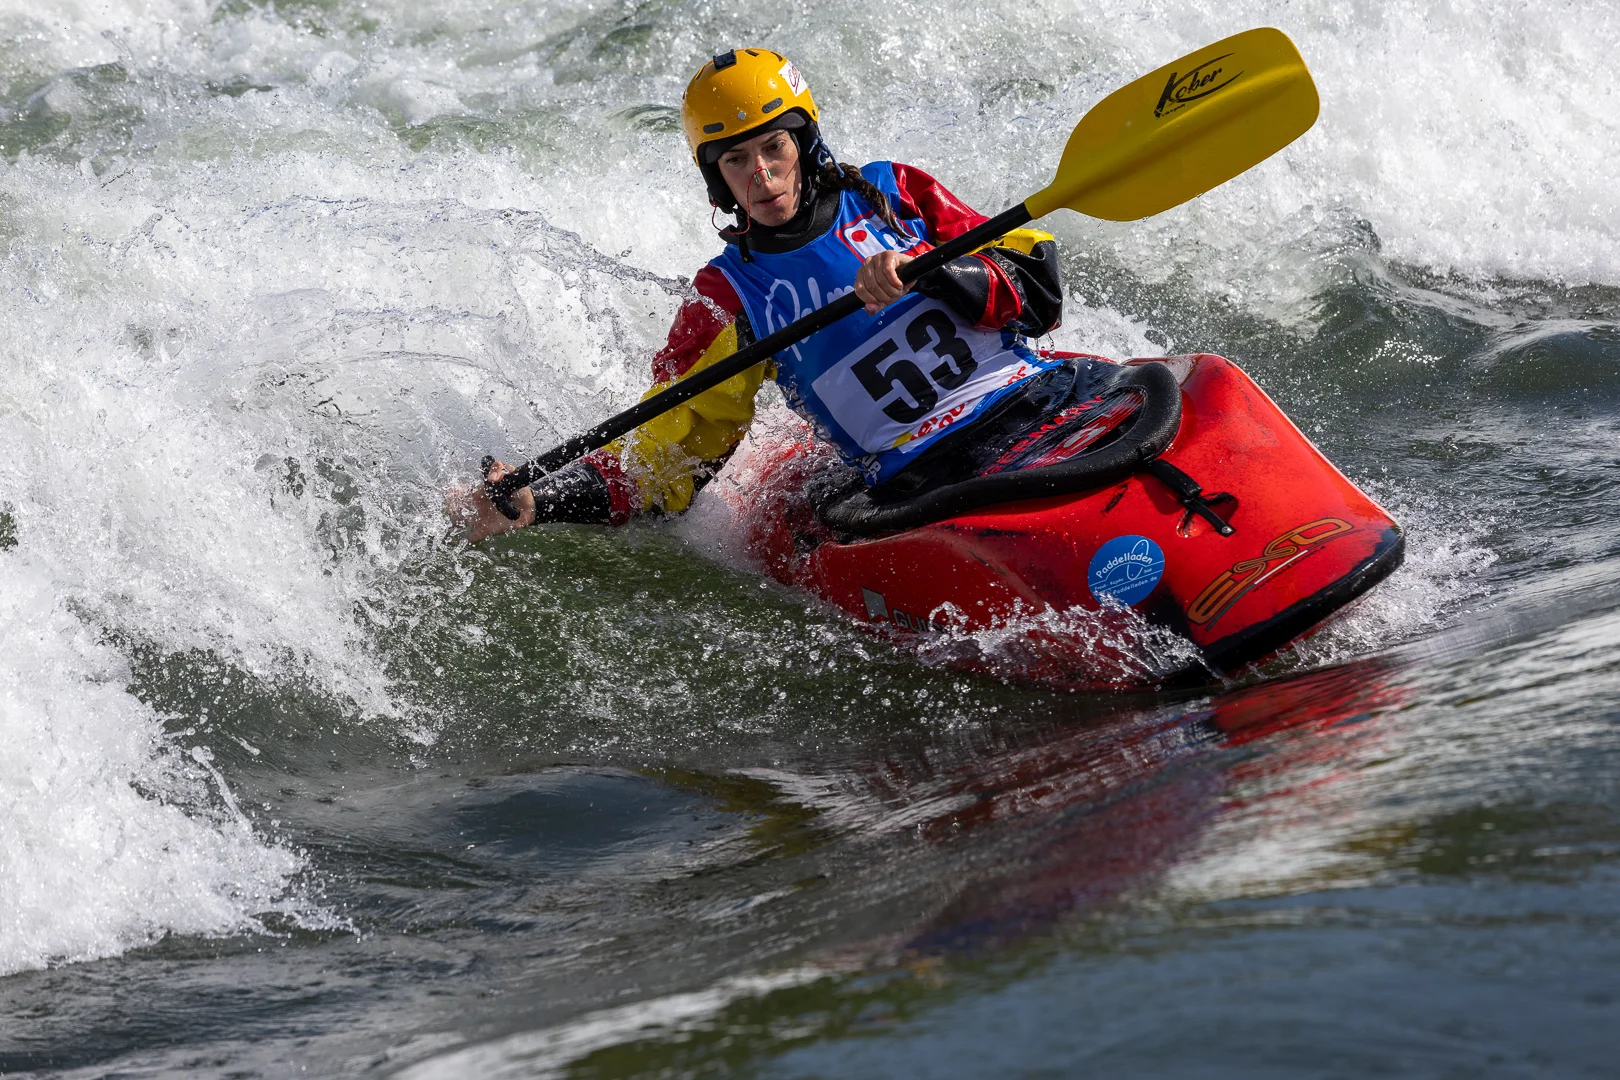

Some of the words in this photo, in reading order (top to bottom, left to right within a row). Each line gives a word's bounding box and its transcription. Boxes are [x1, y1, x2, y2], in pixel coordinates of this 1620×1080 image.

[1154, 52, 1244, 118] Kober
[850, 309, 978, 423] 53
[980, 395, 1104, 477] GERMANY
[1096, 552, 1153, 579] Paddelladen
